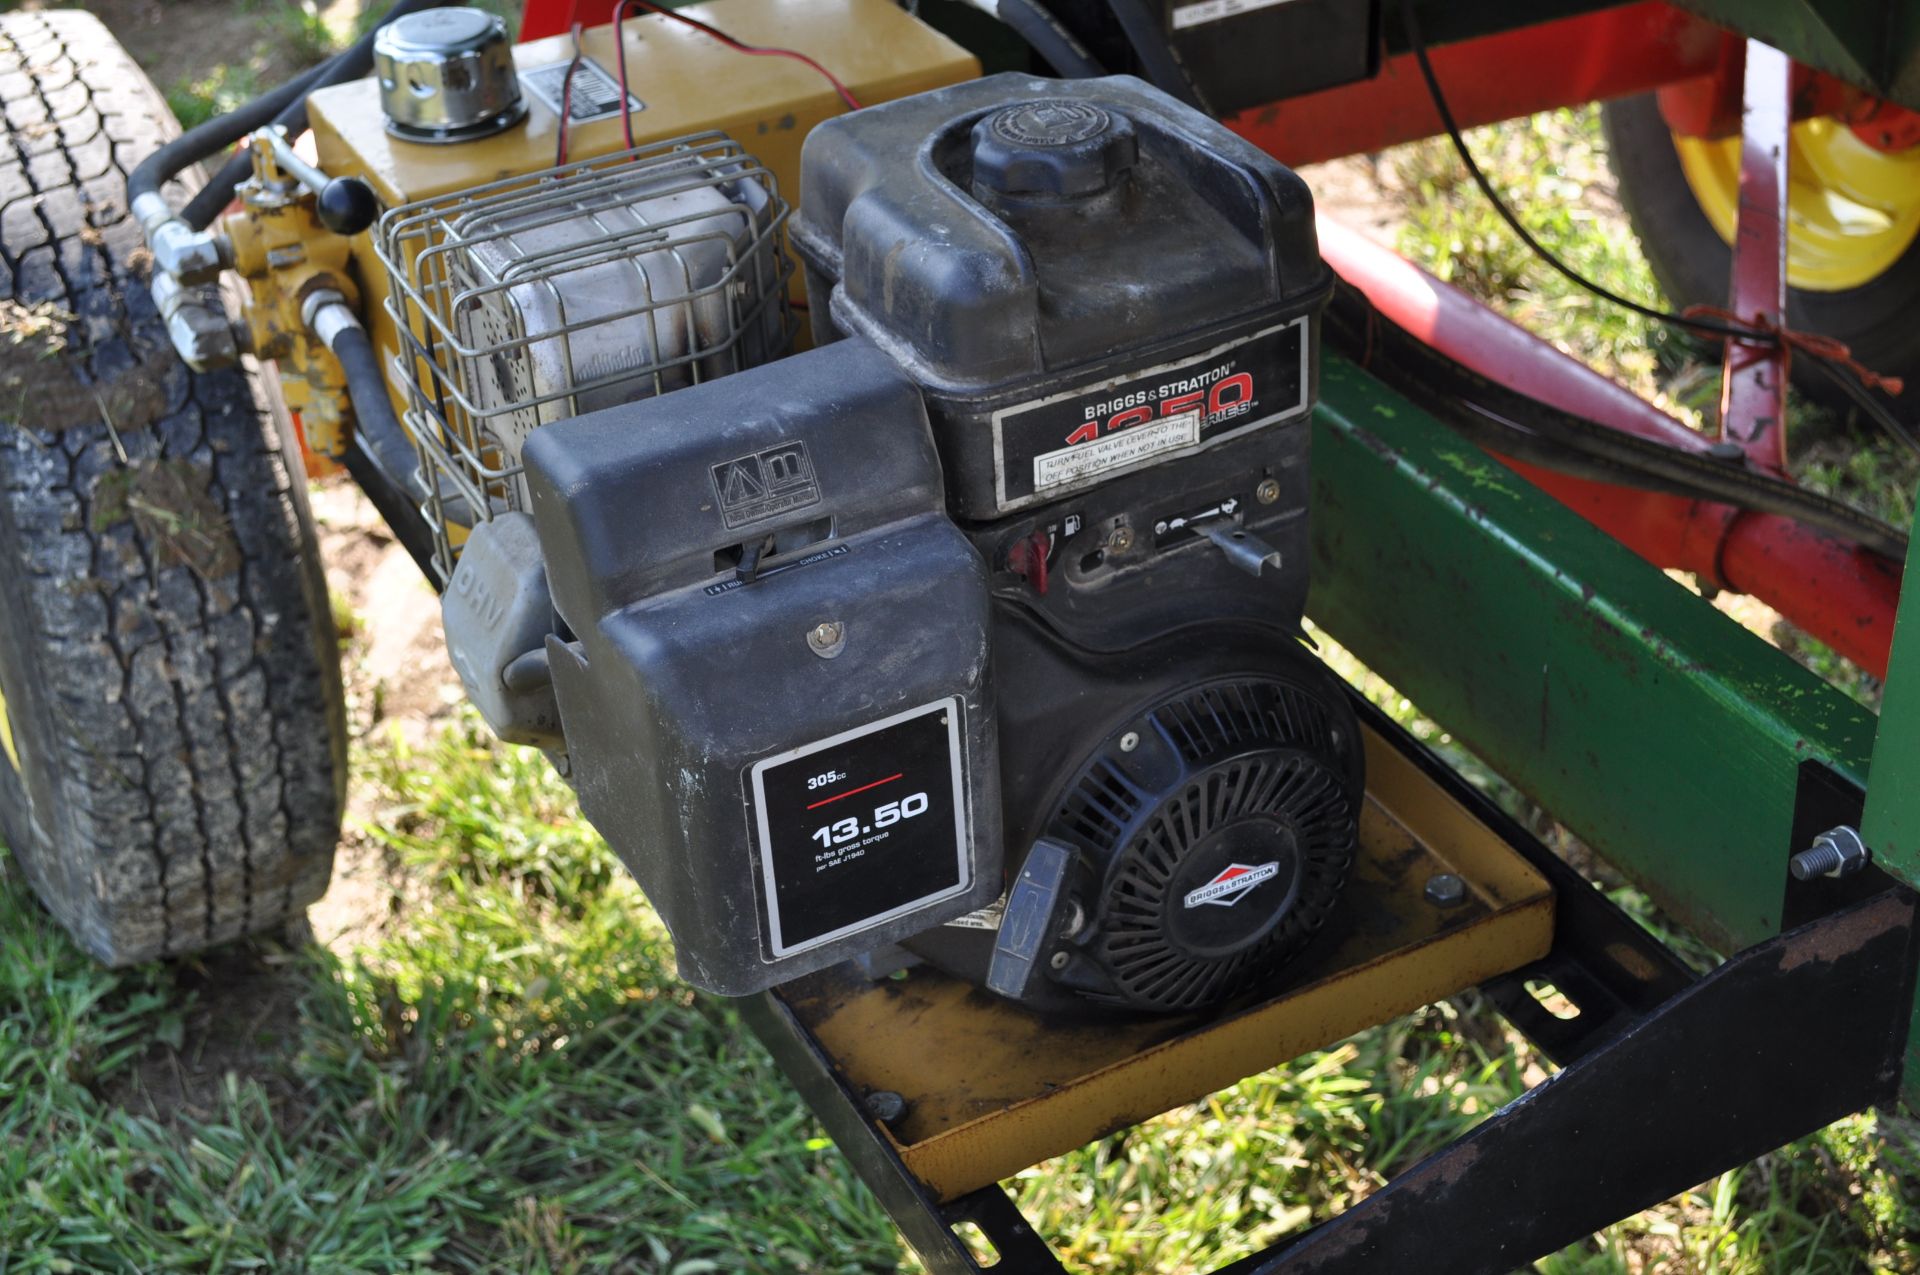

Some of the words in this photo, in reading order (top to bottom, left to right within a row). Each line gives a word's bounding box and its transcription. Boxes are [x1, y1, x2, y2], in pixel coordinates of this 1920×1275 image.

[1085, 392, 1146, 420] BRIGGS
[1046, 456, 1070, 469] TURN
[1071, 449, 1095, 462] FUEL
[1098, 440, 1124, 453] VALVE
[1046, 471, 1062, 481] OFF
[1066, 458, 1108, 477] POSITION
[1110, 449, 1136, 462] WHEN
[1138, 442, 1155, 453] NOT
[1157, 438, 1167, 447] IN
[1168, 434, 1185, 444] USE
[799, 552, 830, 565] CHOKE
[457, 564, 503, 631] OHV
[807, 770, 847, 790] 305cc
[812, 792, 929, 848] 13.50
[815, 849, 836, 863] ft-lbs
[837, 841, 861, 856] gross
[862, 831, 890, 846] torque
[816, 863, 827, 872] per
[828, 857, 842, 867] SAE
[843, 849, 865, 862] J1940
[1190, 885, 1225, 903] BRIGGS
[1231, 867, 1274, 888] STRATTON
